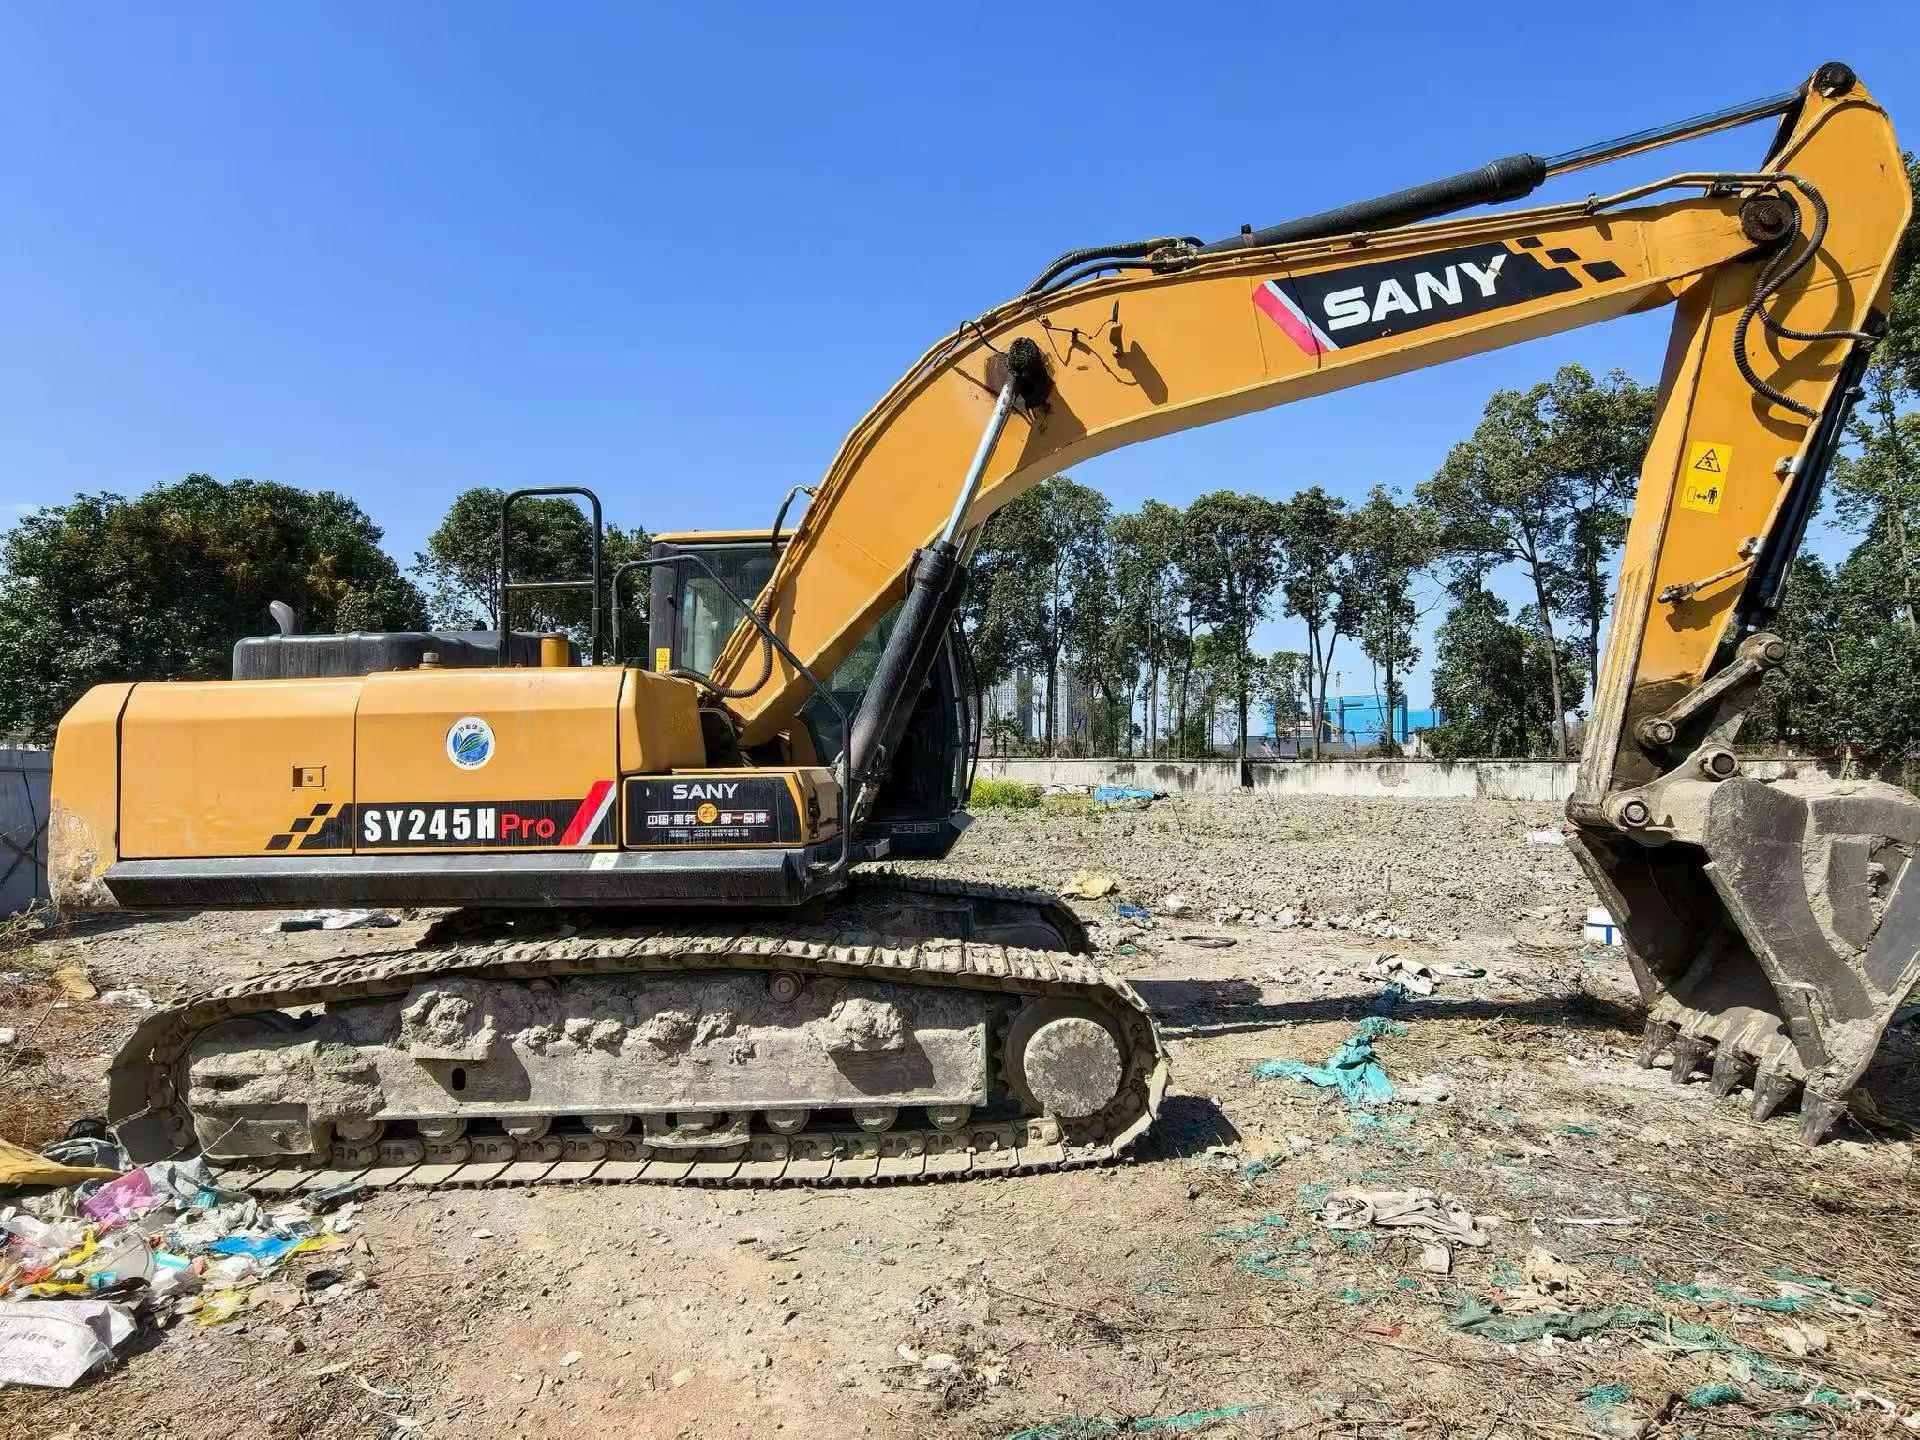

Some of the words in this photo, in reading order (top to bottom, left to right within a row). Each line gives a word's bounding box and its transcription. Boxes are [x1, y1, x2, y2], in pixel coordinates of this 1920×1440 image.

[1323, 253, 1507, 331] SANY
[672, 783, 739, 800] SANY
[364, 808, 496, 842] SY245H
[500, 813, 556, 839] Pro
